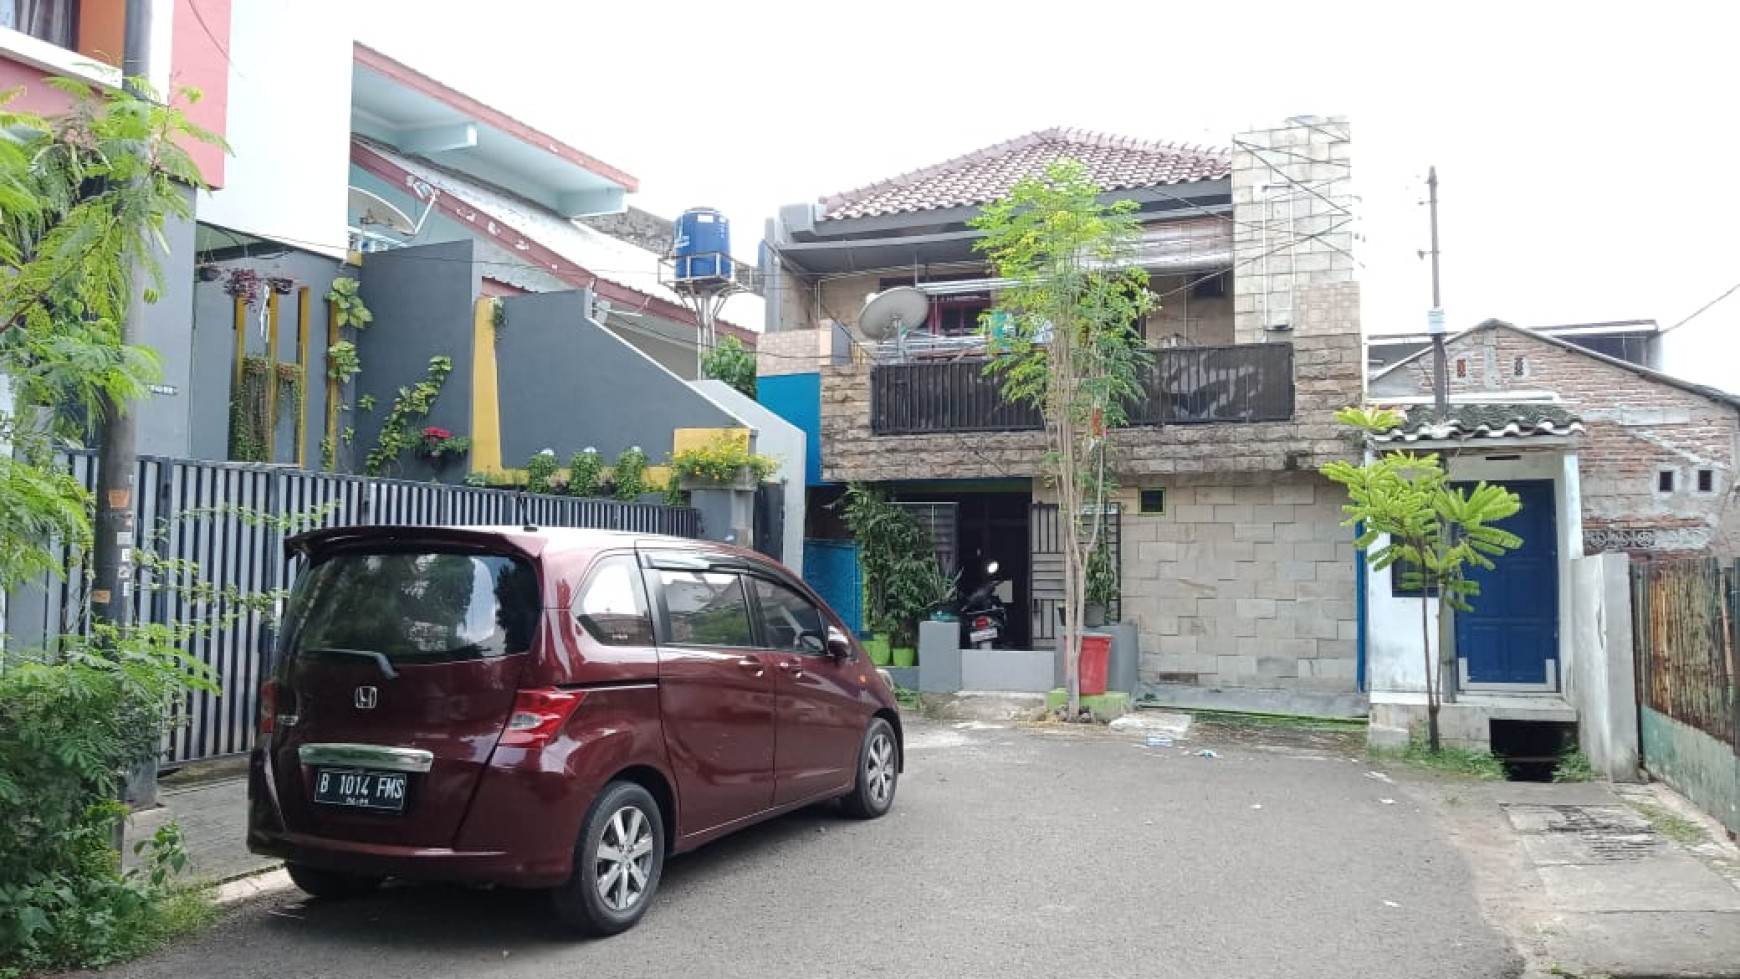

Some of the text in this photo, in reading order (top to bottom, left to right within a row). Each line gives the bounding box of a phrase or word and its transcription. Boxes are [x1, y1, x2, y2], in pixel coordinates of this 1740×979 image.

[320, 772, 404, 799] B 1014 FMS
